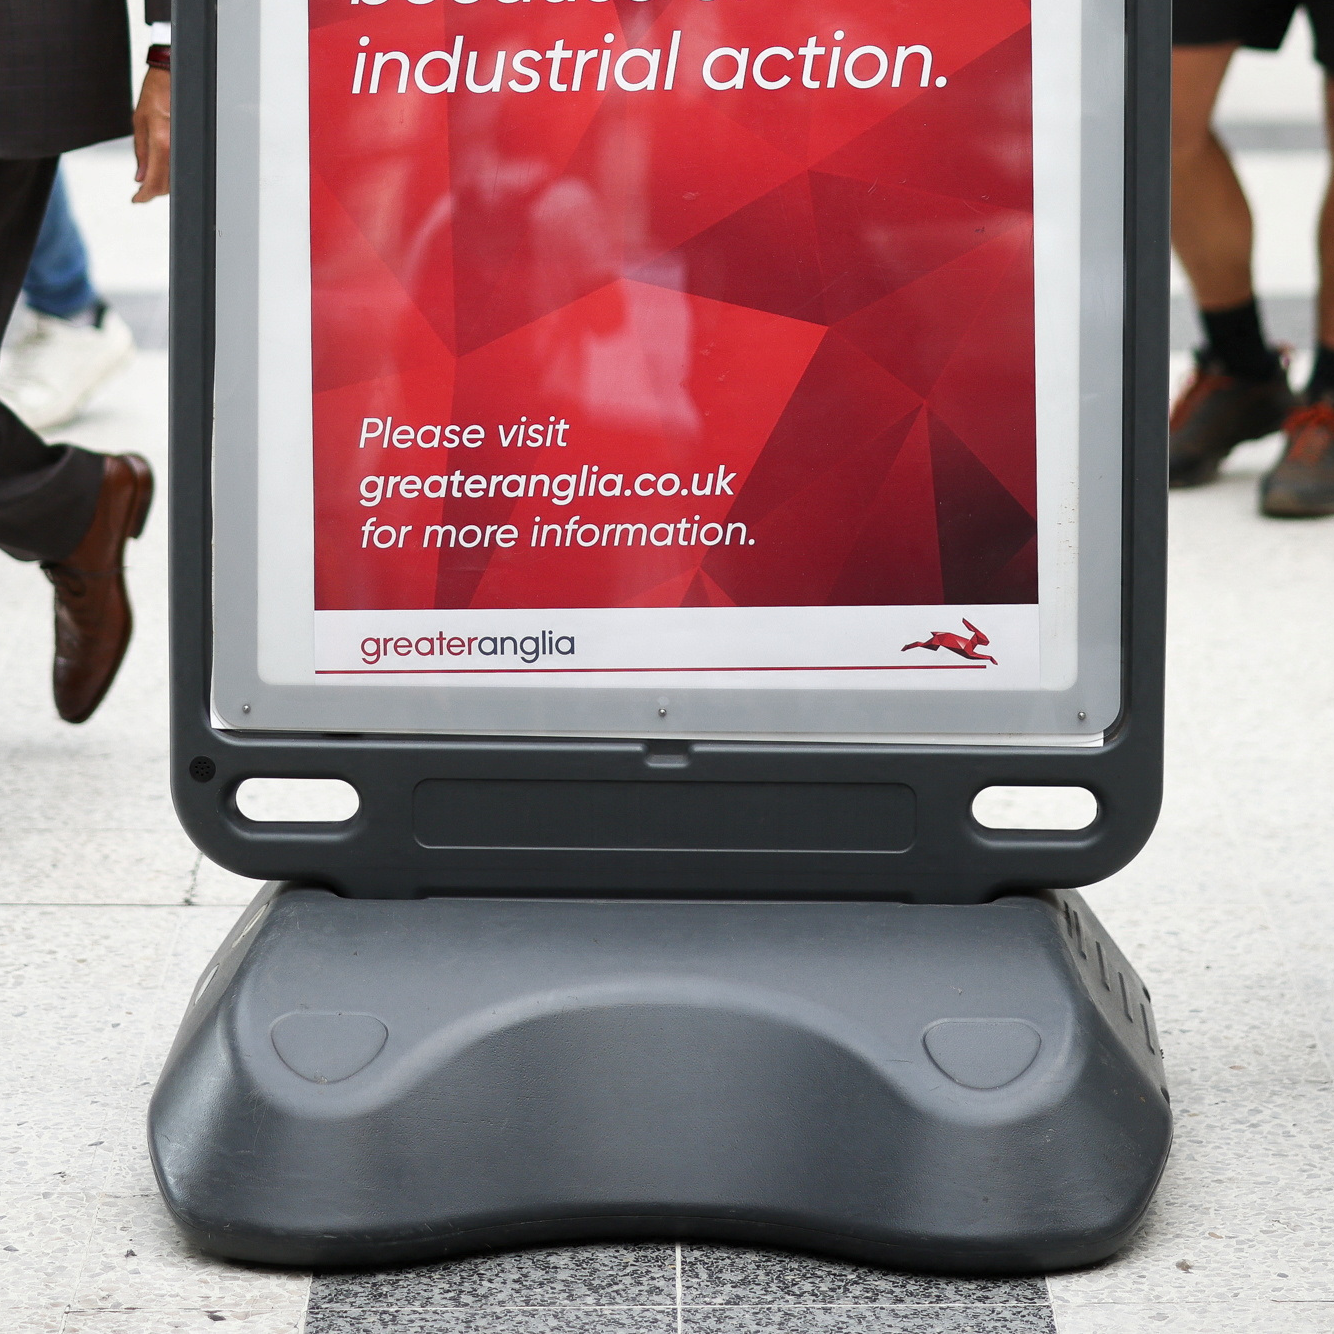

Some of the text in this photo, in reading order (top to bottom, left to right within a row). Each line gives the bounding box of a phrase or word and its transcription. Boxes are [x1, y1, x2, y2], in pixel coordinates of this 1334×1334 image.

[351, 29, 948, 95] industrial action.
[359, 415, 570, 449] Please visit
[359, 464, 737, 507] greateranglia.co.uk
[361, 514, 755, 549] for more information.
[359, 629, 576, 665] greateranglia
